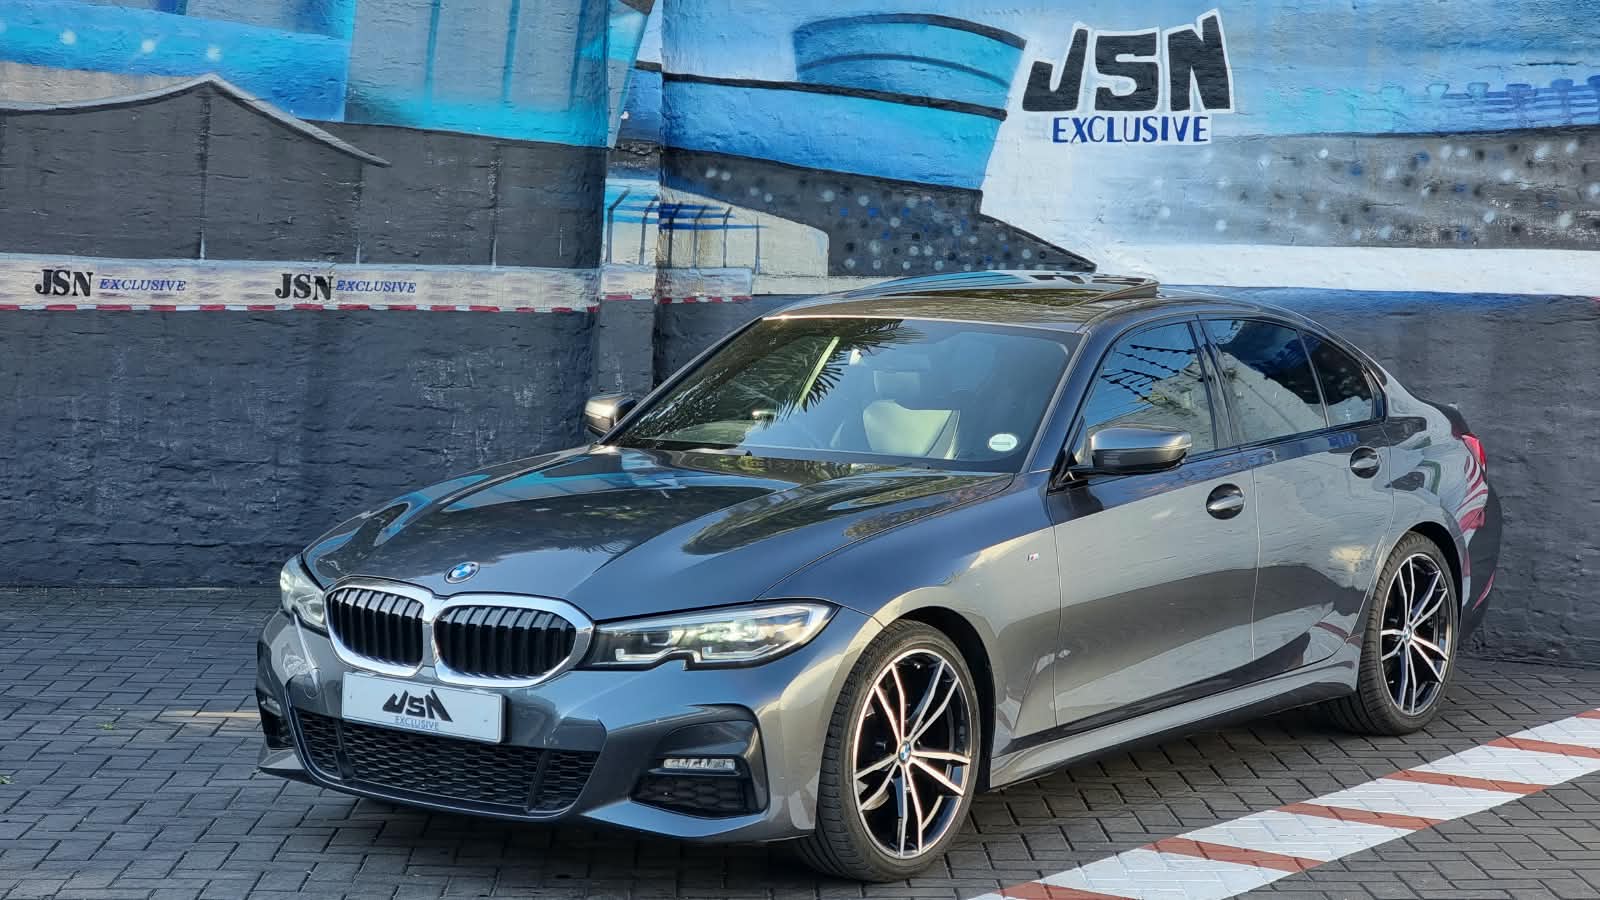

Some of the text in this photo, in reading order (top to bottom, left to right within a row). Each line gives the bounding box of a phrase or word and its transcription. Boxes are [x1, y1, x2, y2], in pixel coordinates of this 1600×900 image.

[1022, 15, 1231, 112] JSN
[1052, 116, 1209, 144] EXCLUSIVE
[35, 269, 186, 297] JSN EXCLUSIVE
[275, 273, 417, 301] JSN EXCLUSIVE
[382, 687, 454, 723] JSN
[395, 715, 440, 731] EXCLUSIVE
